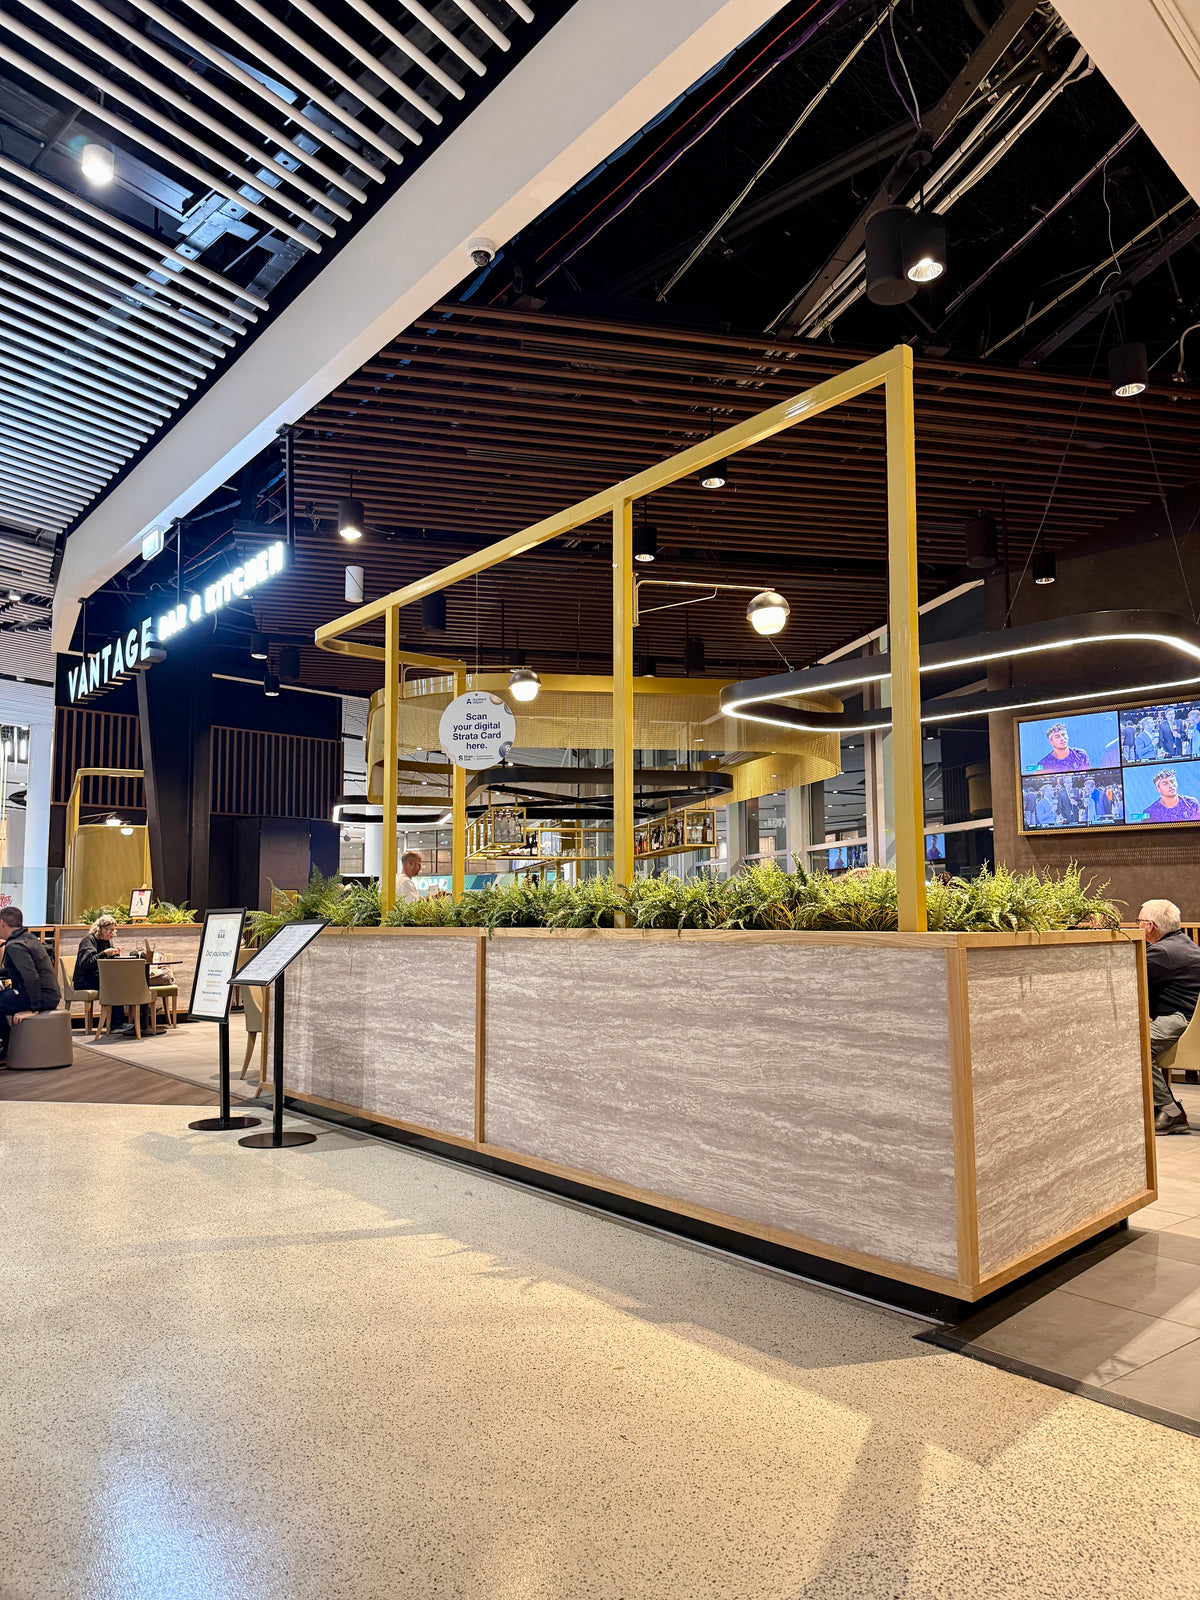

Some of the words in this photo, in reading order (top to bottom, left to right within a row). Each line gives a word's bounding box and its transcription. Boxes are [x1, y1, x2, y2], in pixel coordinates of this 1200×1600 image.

[68, 617, 152, 703] VANTAGE
[158, 604, 187, 641] BAR
[204, 541, 284, 613] KITCHEN
[453, 724, 472, 732] your
[474, 722, 501, 731] digital
